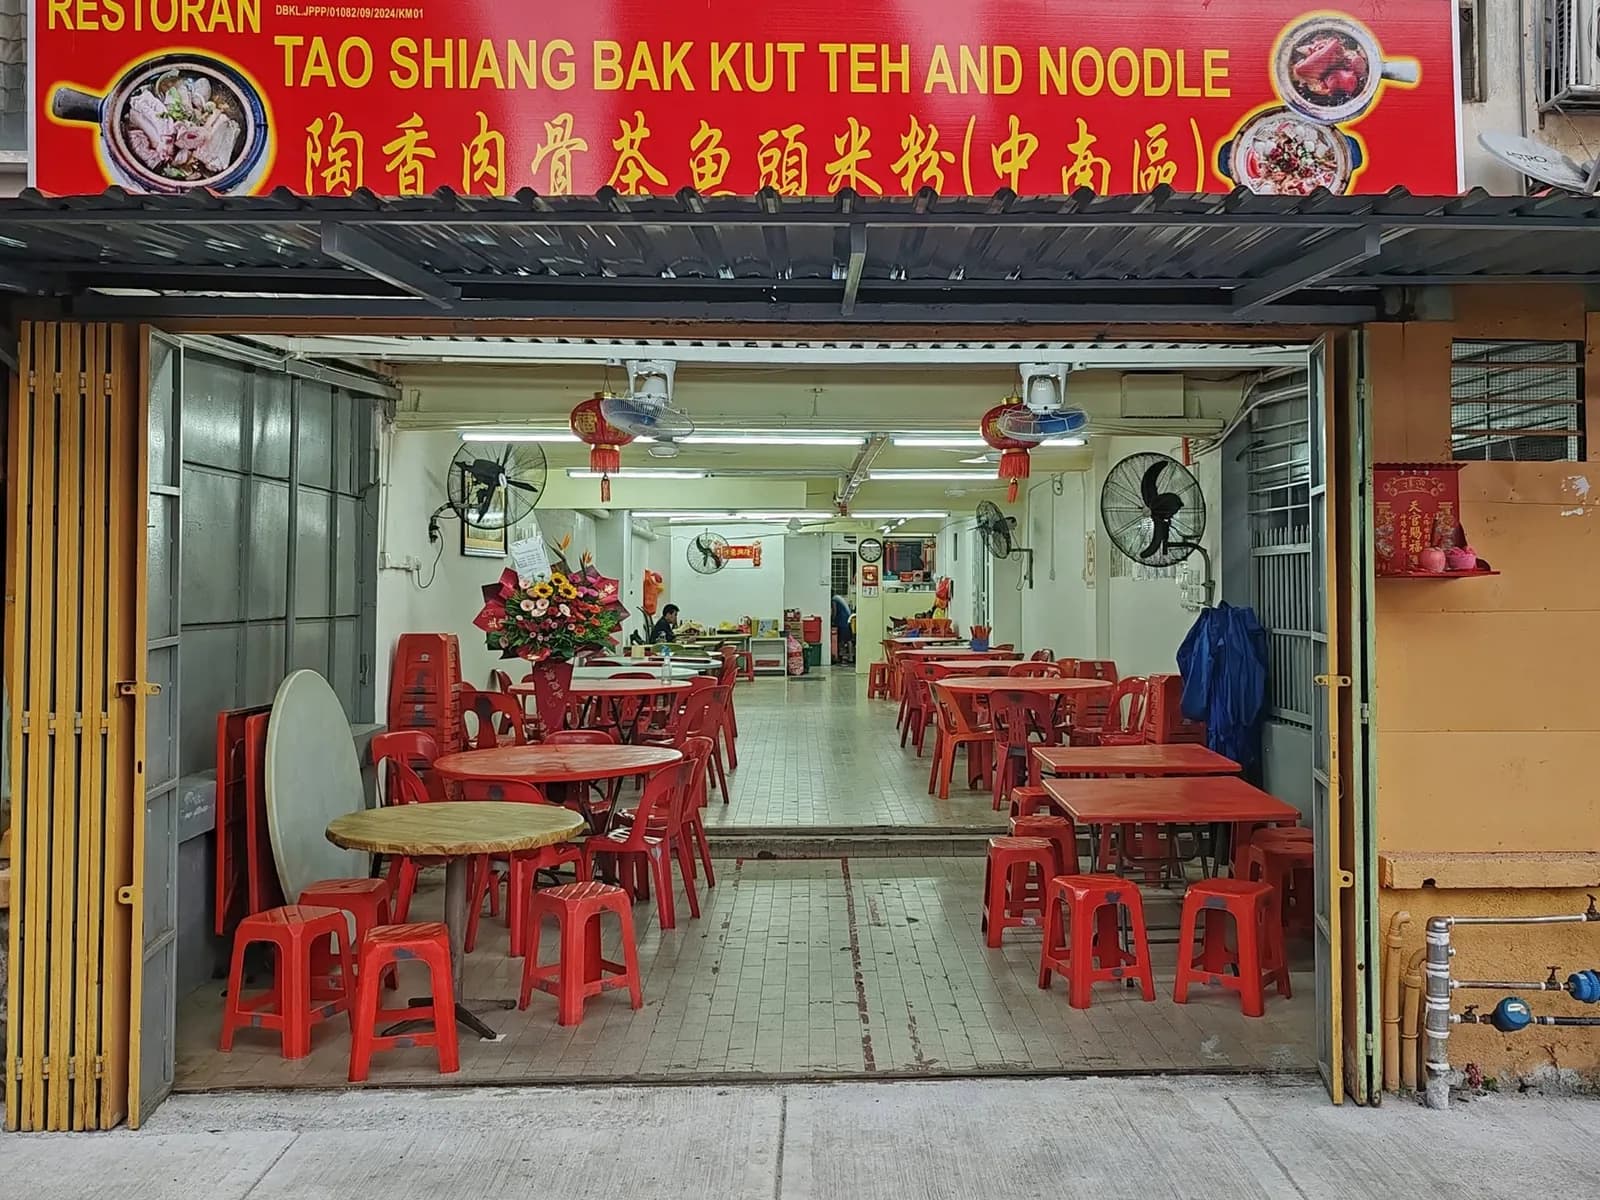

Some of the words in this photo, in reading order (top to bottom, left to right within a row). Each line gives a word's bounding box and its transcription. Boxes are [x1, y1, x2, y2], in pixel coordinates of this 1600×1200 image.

[48, 0, 261, 33] RESTORAN
[274, 35, 373, 89] TAO
[389, 37, 576, 91] SHIANG
[593, 40, 695, 91] BAK
[710, 42, 805, 92] KUT
[818, 43, 910, 94] TEH
[924, 45, 1023, 95] AND
[1039, 46, 1231, 98] NOODLE
